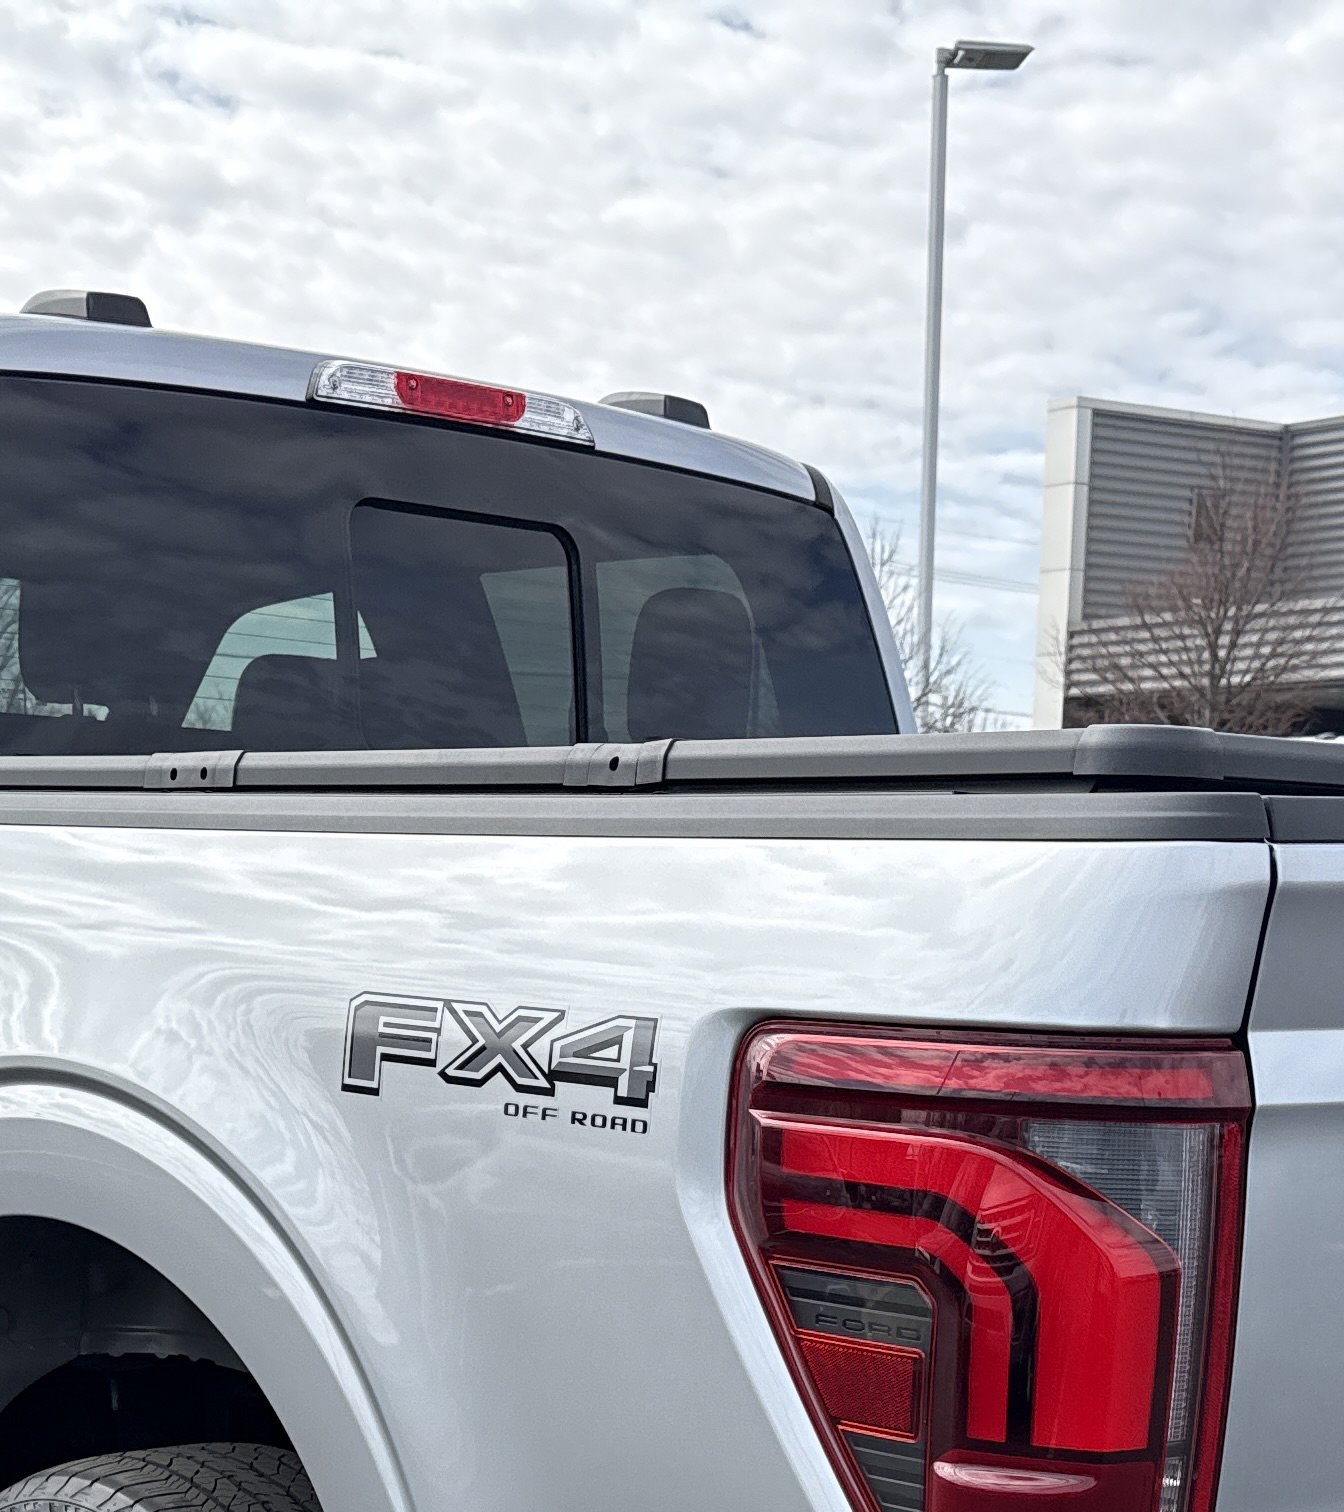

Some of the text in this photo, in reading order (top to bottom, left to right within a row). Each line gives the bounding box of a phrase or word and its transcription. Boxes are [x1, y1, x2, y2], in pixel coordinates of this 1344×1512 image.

[341, 990, 659, 1109] FX4
[504, 1102, 648, 1134] OFF ROAD
[815, 1313, 922, 1342] FORD
